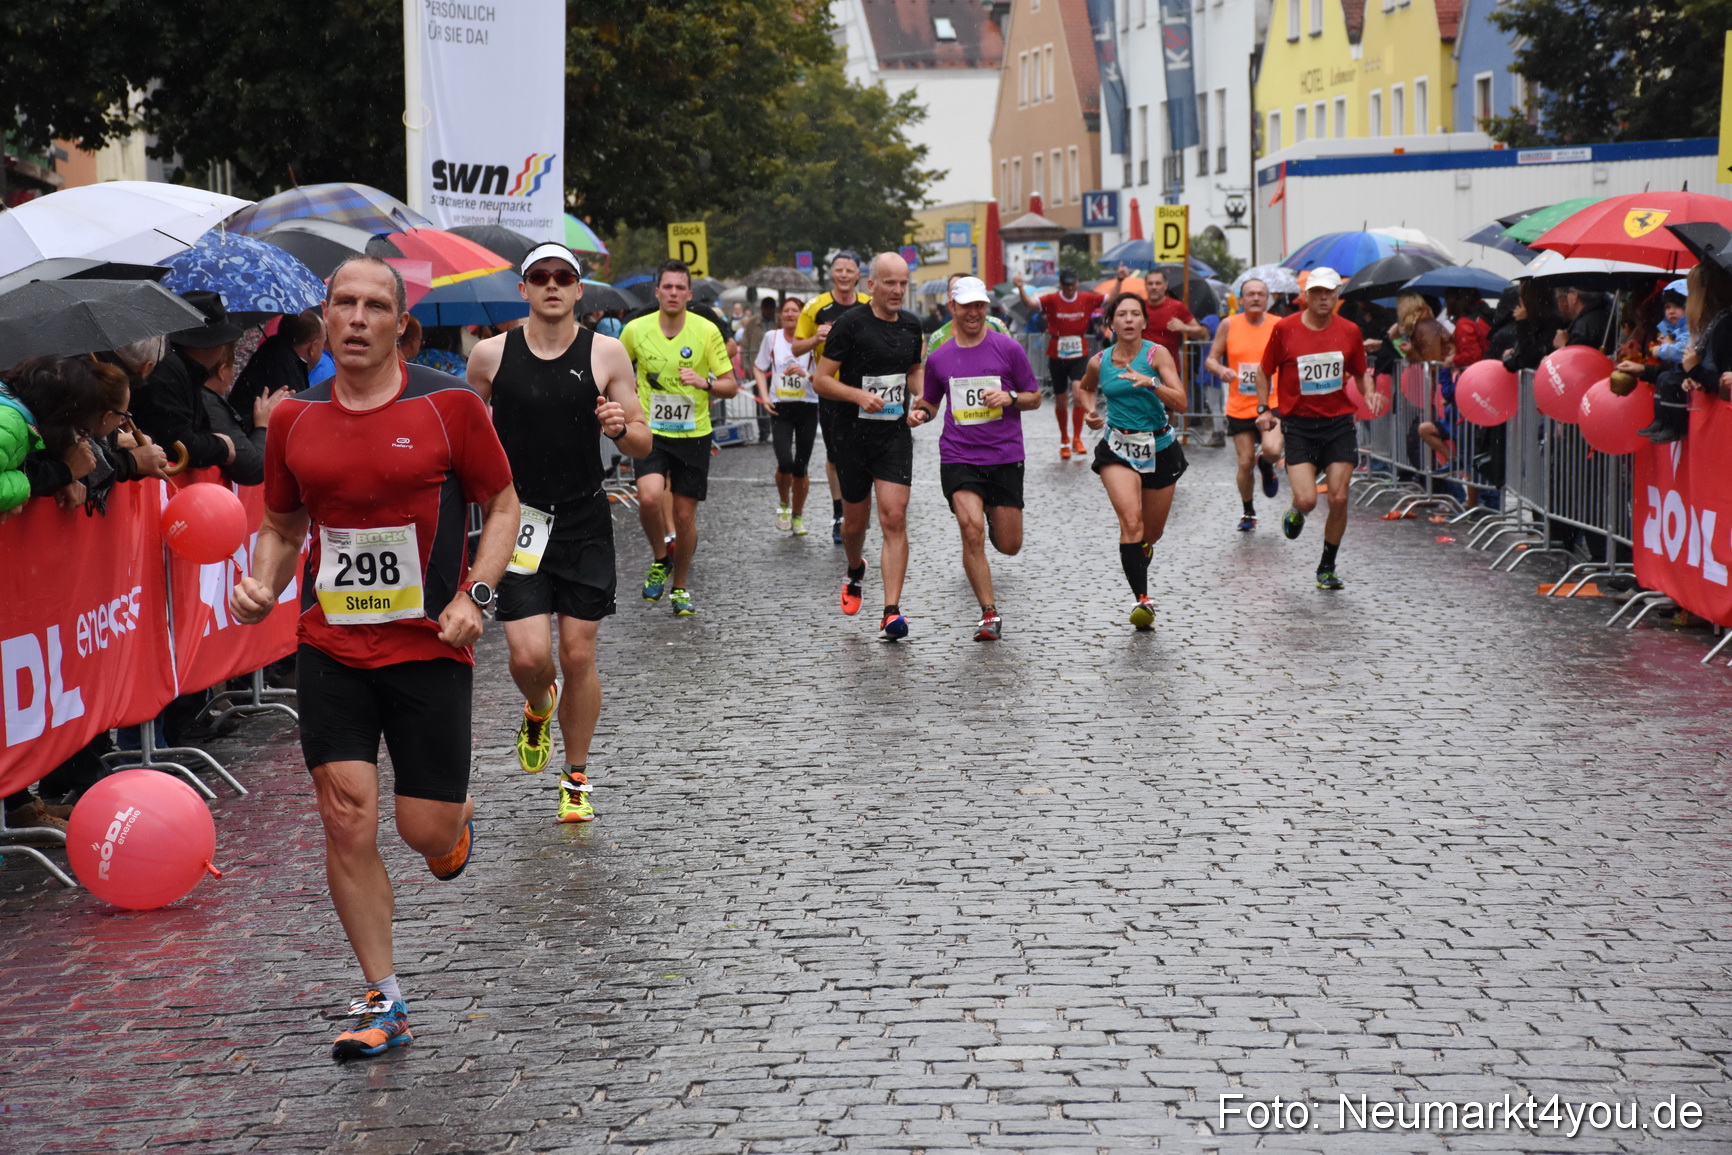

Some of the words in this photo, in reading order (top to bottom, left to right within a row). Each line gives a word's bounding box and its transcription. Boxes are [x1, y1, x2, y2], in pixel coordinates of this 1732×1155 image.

[428, 20, 442, 40] ÜR
[444, 26, 462, 43] SIE
[466, 28, 489, 45] DA!
[1300, 68, 1324, 94] HOTEL
[432, 159, 509, 195] swn
[479, 200, 532, 212] neumarkt
[1159, 208, 1185, 217] Block
[672, 225, 701, 236] Block
[1164, 223, 1180, 249] D
[679, 240, 697, 266] D
[1242, 372, 1256, 383] 26
[1304, 362, 1340, 380] 2078
[781, 376, 801, 389] 146
[966, 389, 986, 407] 69
[655, 404, 691, 420] 2847
[1114, 441, 1151, 458] 2134
[355, 530, 407, 544] BOCK
[334, 551, 400, 587] 298
[346, 596, 391, 610] Stefan
[0, 624, 85, 748] DL
[91, 806, 135, 880] RÖDL
